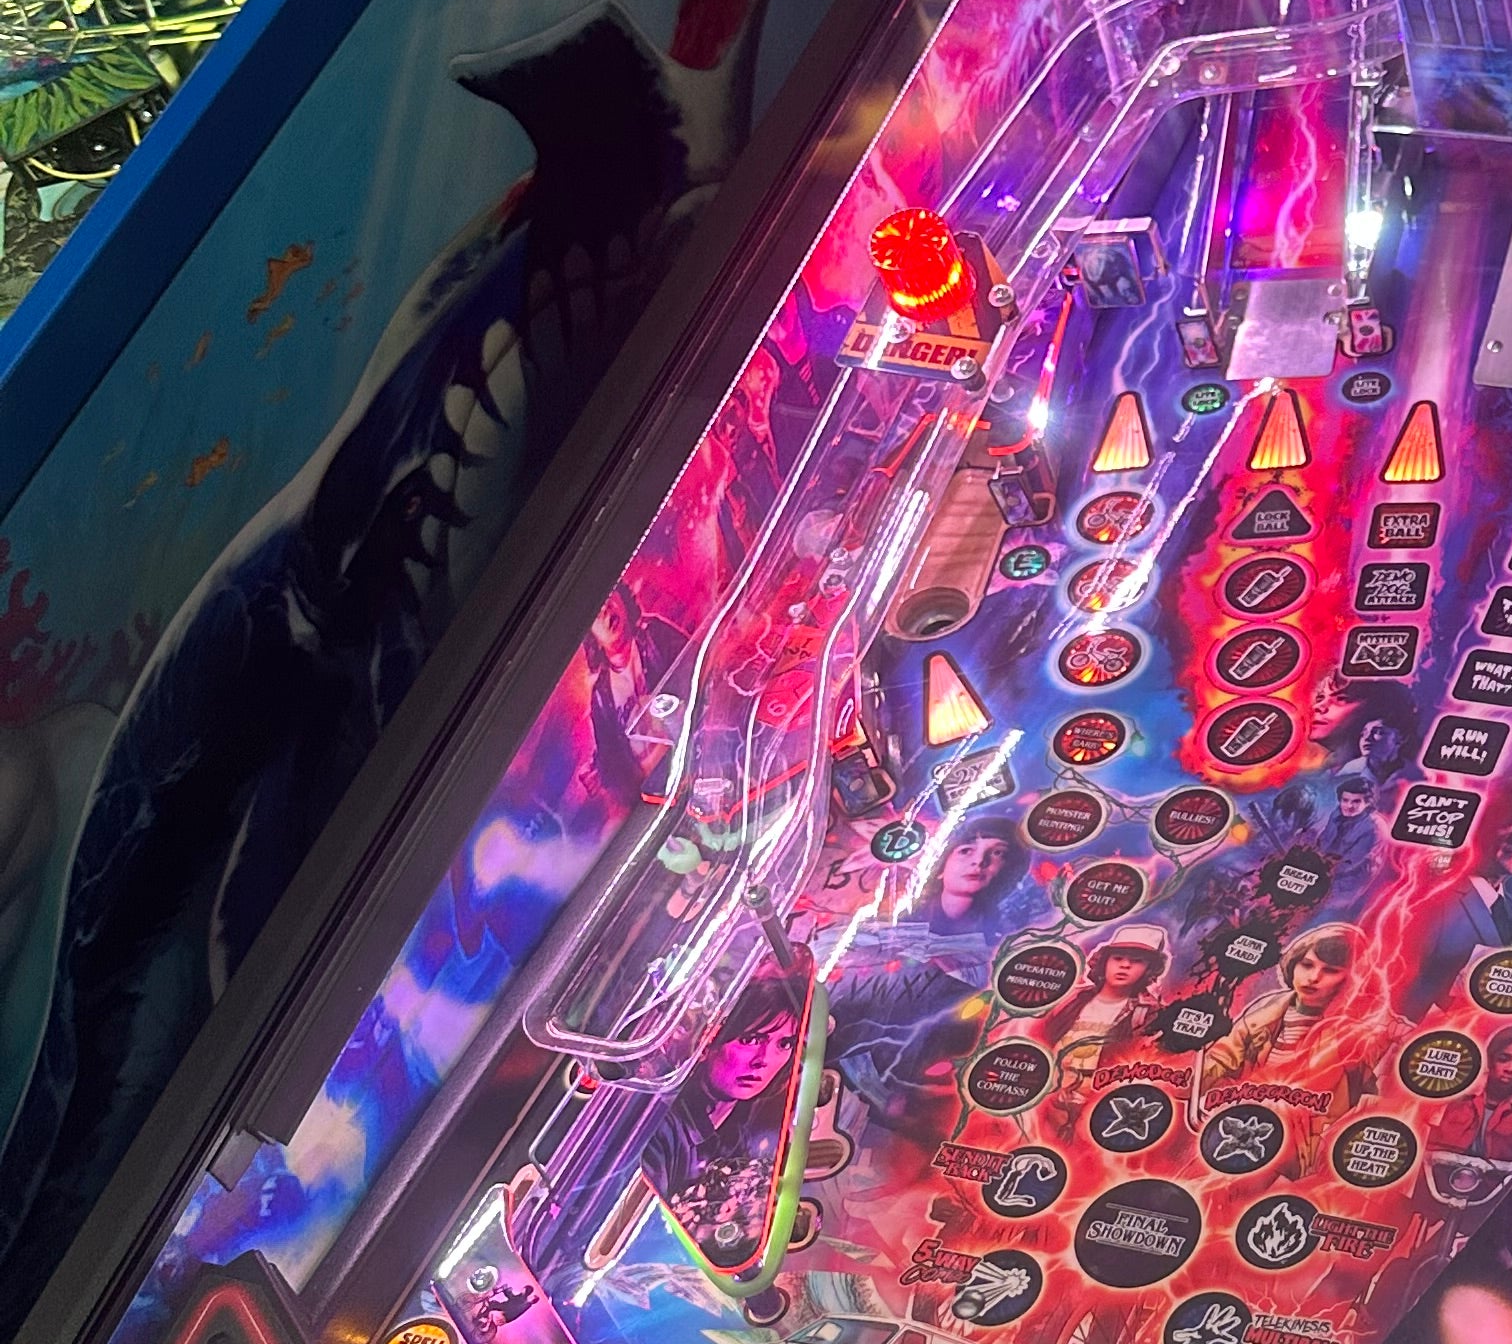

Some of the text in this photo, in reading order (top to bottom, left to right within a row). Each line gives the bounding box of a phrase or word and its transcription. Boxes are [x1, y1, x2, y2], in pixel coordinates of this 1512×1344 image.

[1256, 511, 1290, 522] LOCK
[1382, 514, 1429, 527] EXTRA
[1255, 521, 1289, 533] BALL
[1384, 527, 1424, 539] BALL
[1365, 594, 1416, 605] ATTACK
[1358, 633, 1409, 645] MYSTERY
[1472, 675, 1512, 693] THAT?
[1451, 728, 1488, 745] RUN
[1440, 745, 1488, 764] WILL!
[1415, 794, 1468, 809] CAN'T
[1046, 807, 1092, 821] MONSTER
[1169, 811, 1216, 825] BULLIES!
[1407, 808, 1465, 824] STOP
[1407, 823, 1454, 839] THIS!
[1280, 865, 1318, 885] BREAK
[1088, 879, 1130, 894] GET ME
[1277, 877, 1308, 894] OUT!
[1088, 895, 1116, 906] OUT!
[1235, 935, 1267, 952] JUNK
[1225, 945, 1262, 964] YARD!
[1014, 962, 1067, 978] OPERATION
[1181, 1008, 1214, 1026] IT'S A
[1173, 1019, 1208, 1037] TRAP!
[1427, 1048, 1459, 1063] LURE
[993, 1057, 1037, 1072] FOLLOW
[1418, 1063, 1458, 1079] DART!
[1000, 1070, 1020, 1083] THE
[1093, 1062, 1193, 1090] DEMODOG!
[976, 1078, 1029, 1097] COMPASS!
[1204, 1083, 1333, 1114] DEMOGORGON!
[1364, 1127, 1399, 1144] TURN
[938, 1146, 988, 1167] SEND
[1352, 1142, 1398, 1162] UP THE
[946, 1163, 989, 1183] BACK
[1348, 1158, 1390, 1176] HEAT!
[1115, 1211, 1168, 1233] FINAL
[1314, 1215, 1360, 1238] LIGHT
[1087, 1221, 1185, 1256] SHOWDOWN
[1321, 1233, 1374, 1259] FIRE
[912, 1239, 982, 1271] 5-WAY
[1253, 1313, 1331, 1334] TELEKINESIS
